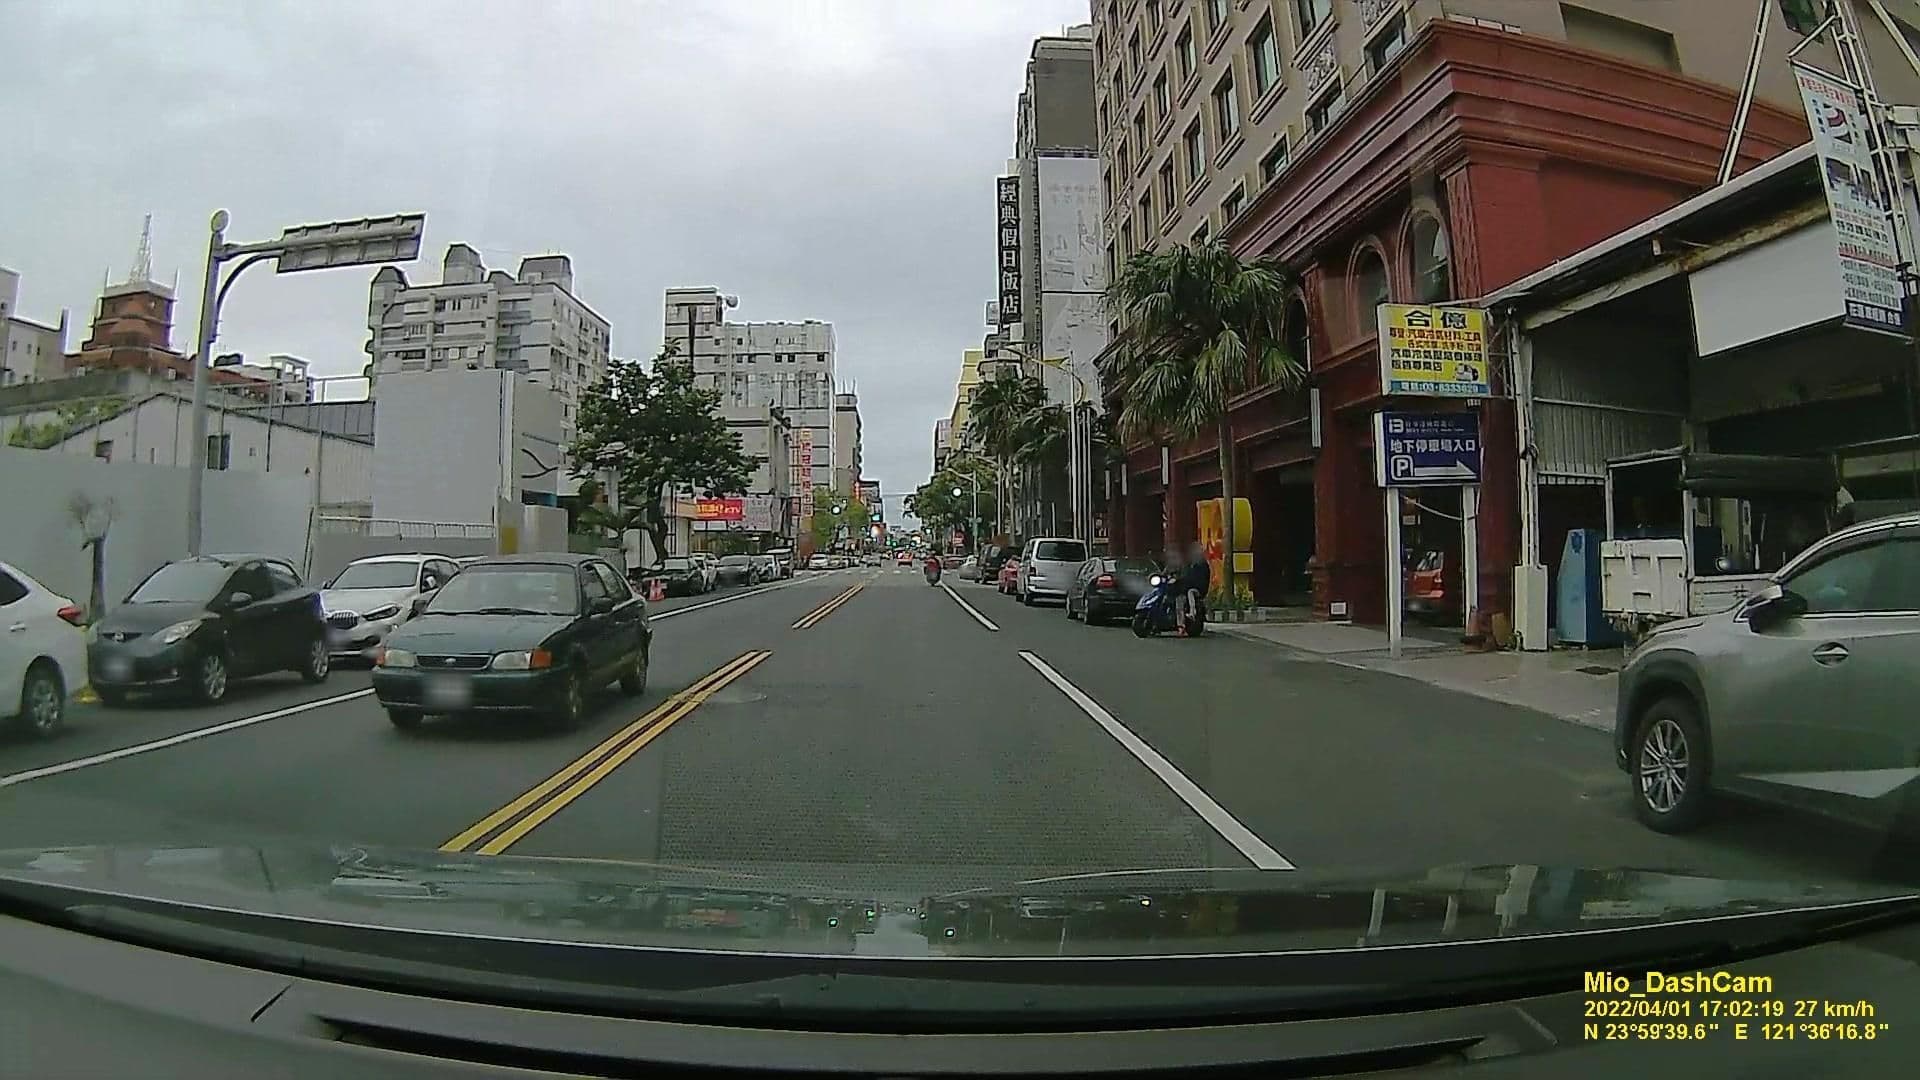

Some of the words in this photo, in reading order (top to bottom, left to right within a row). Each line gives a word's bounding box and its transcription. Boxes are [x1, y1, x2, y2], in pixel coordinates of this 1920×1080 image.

[999, 183, 1021, 315] 經典假日飯店
[1390, 439, 1476, 454] 地下停車場入口
[1396, 459, 1409, 477] P
